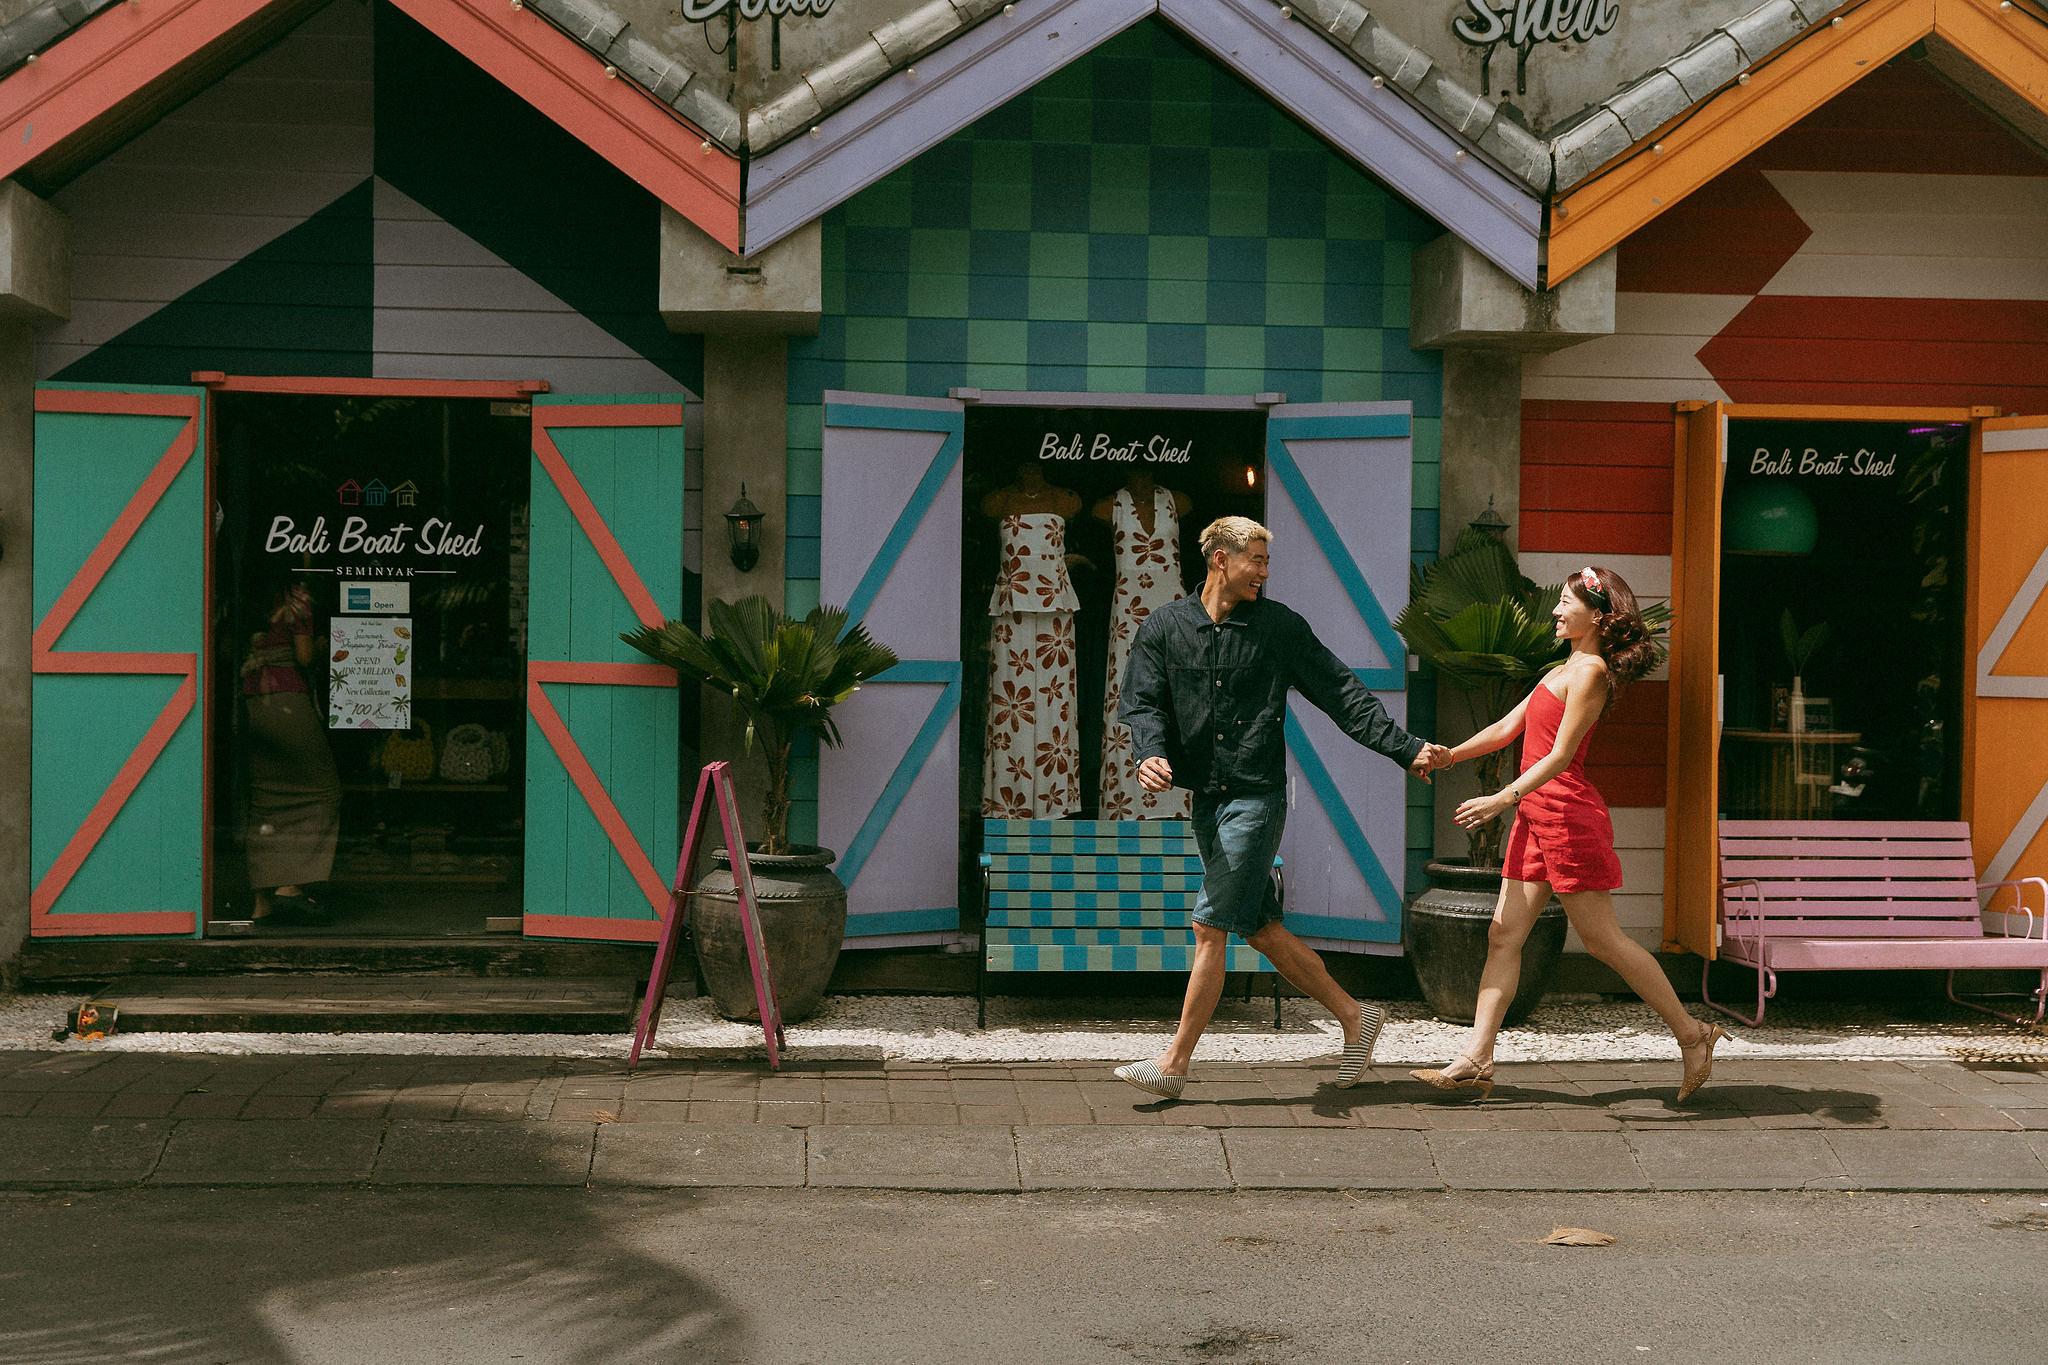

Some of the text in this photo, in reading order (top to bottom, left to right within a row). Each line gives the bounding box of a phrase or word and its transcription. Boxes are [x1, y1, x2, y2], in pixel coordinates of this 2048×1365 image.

[1039, 432, 1193, 464] Bali Boat Shed
[1750, 447, 1897, 477] Bali Boat Shed
[265, 515, 485, 557] Bali Boat Shed
[336, 566, 416, 577] SEMINYAK
[374, 601, 394, 610] Open
[354, 656, 381, 665] SPEND
[356, 667, 361, 675] 2
[361, 666, 396, 675] MILLION
[359, 687, 391, 696] Collection
[351, 703, 373, 716] 100
